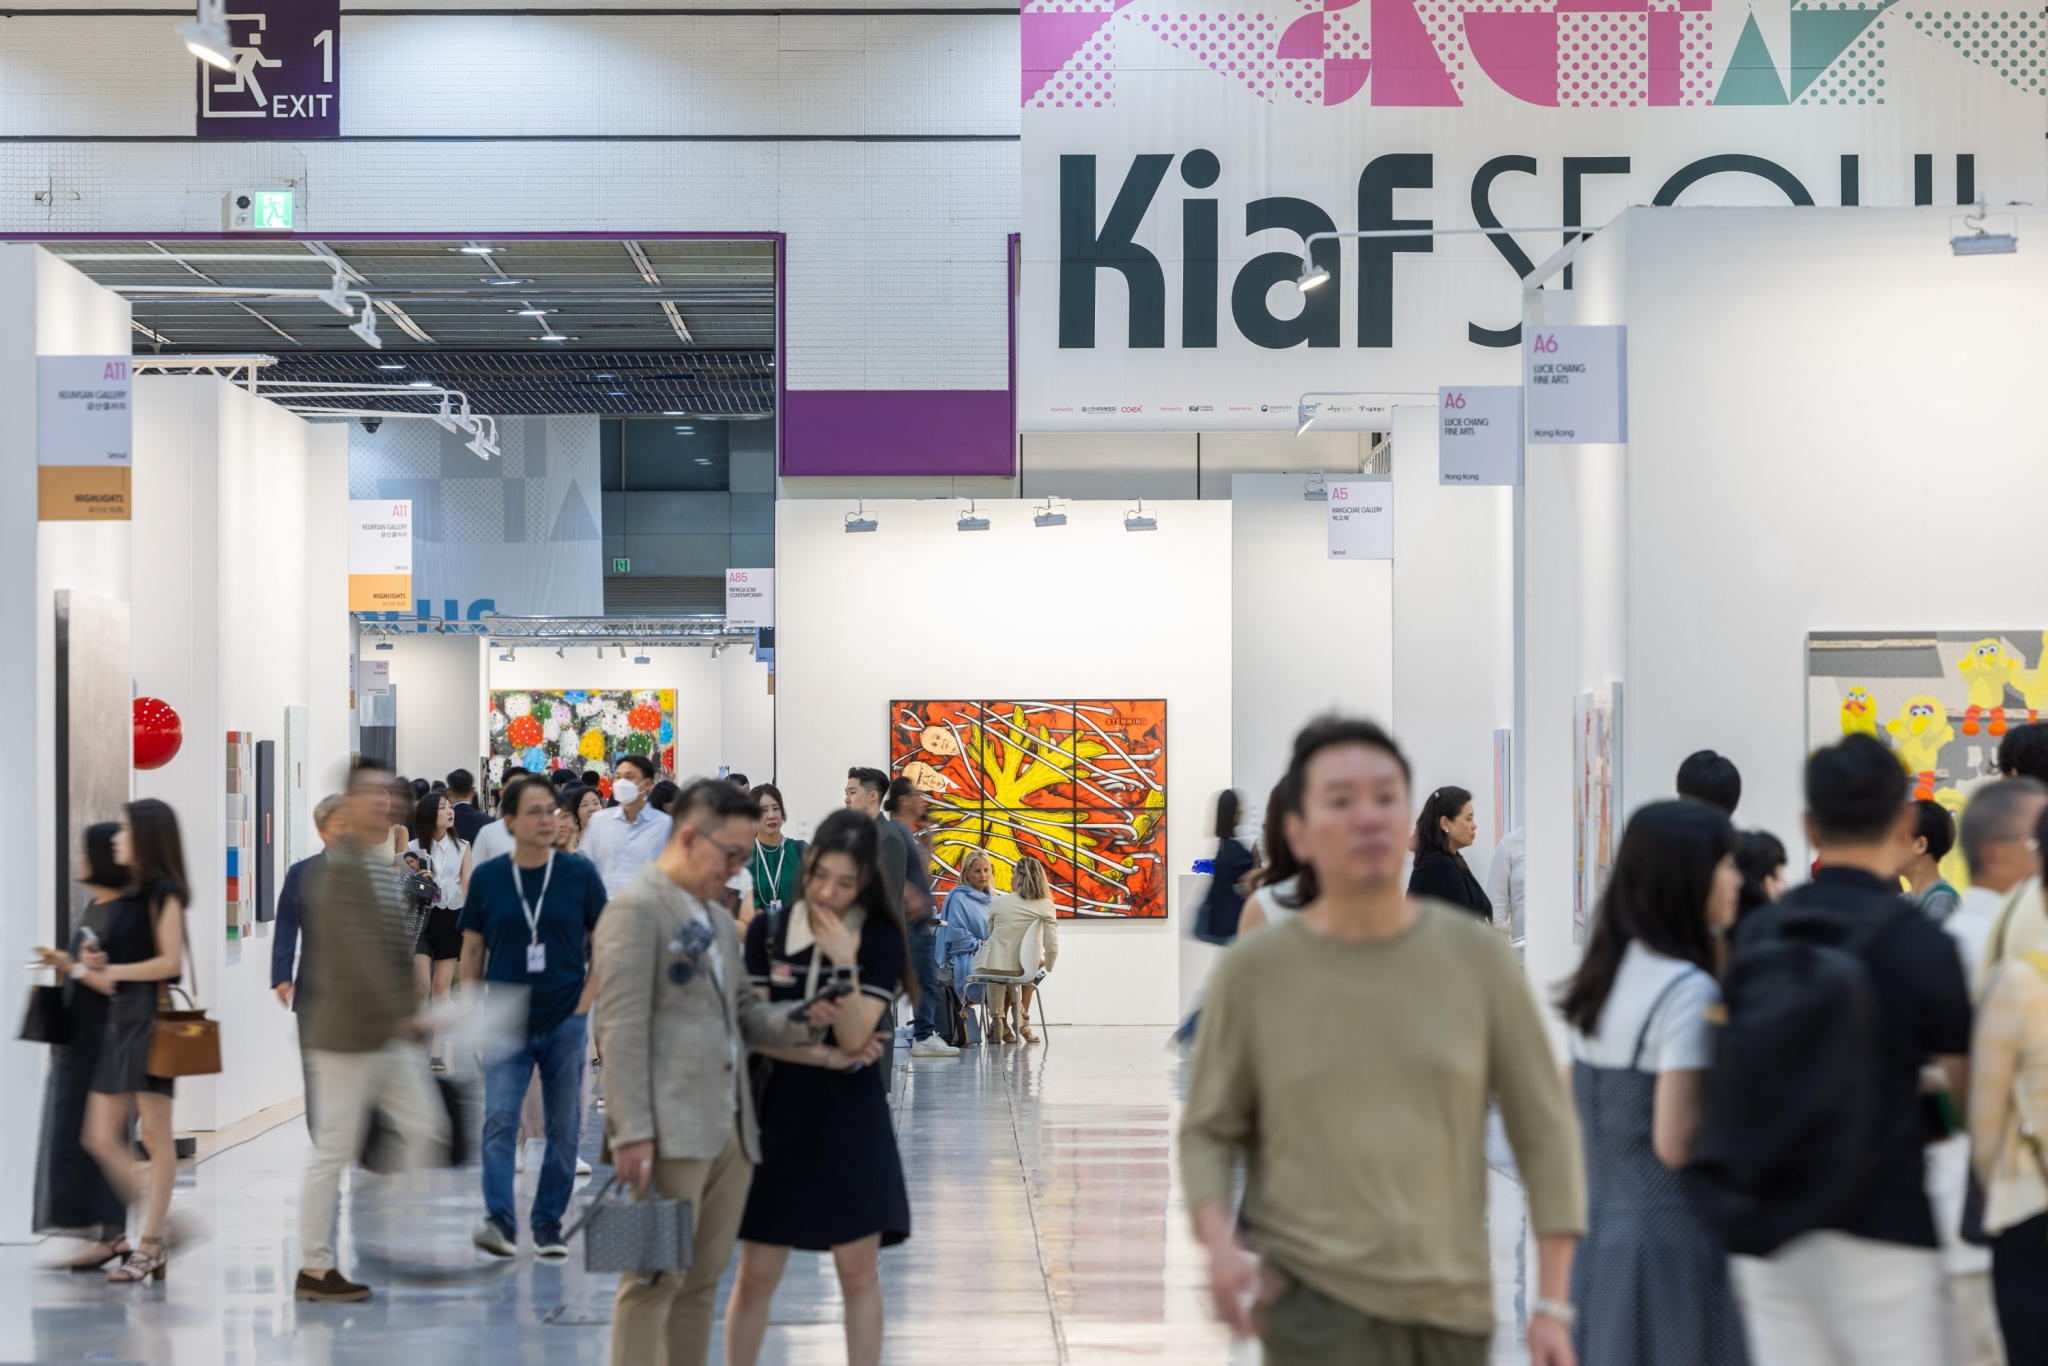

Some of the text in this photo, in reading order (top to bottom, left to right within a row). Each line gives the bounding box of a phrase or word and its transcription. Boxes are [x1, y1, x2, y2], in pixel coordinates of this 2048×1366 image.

[313, 29, 333, 83] 1
[272, 94, 333, 118] EXIT
[1058, 148, 1434, 350] Kiaf
[1533, 333, 1559, 354] A6
[103, 362, 126, 380] A11
[1533, 363, 1586, 374] LUCIE CHANG
[1533, 375, 1570, 385] FINE ARTS
[58, 390, 126, 400] KEUMSAN GALLERY
[1444, 392, 1466, 409] A6
[1121, 404, 1143, 413] coex
[1444, 418, 1489, 426] LUCIE CHANG
[1444, 427, 1475, 436] FINE ARTS
[1534, 429, 1575, 438] Hong Kong
[107, 451, 127, 459] Seoul
[1444, 473, 1479, 481] Hong Kong
[74, 494, 124, 503] HIGHLIGHTS
[1332, 487, 1348, 500] A5
[392, 504, 407, 518] A11
[729, 572, 748, 582] A85
